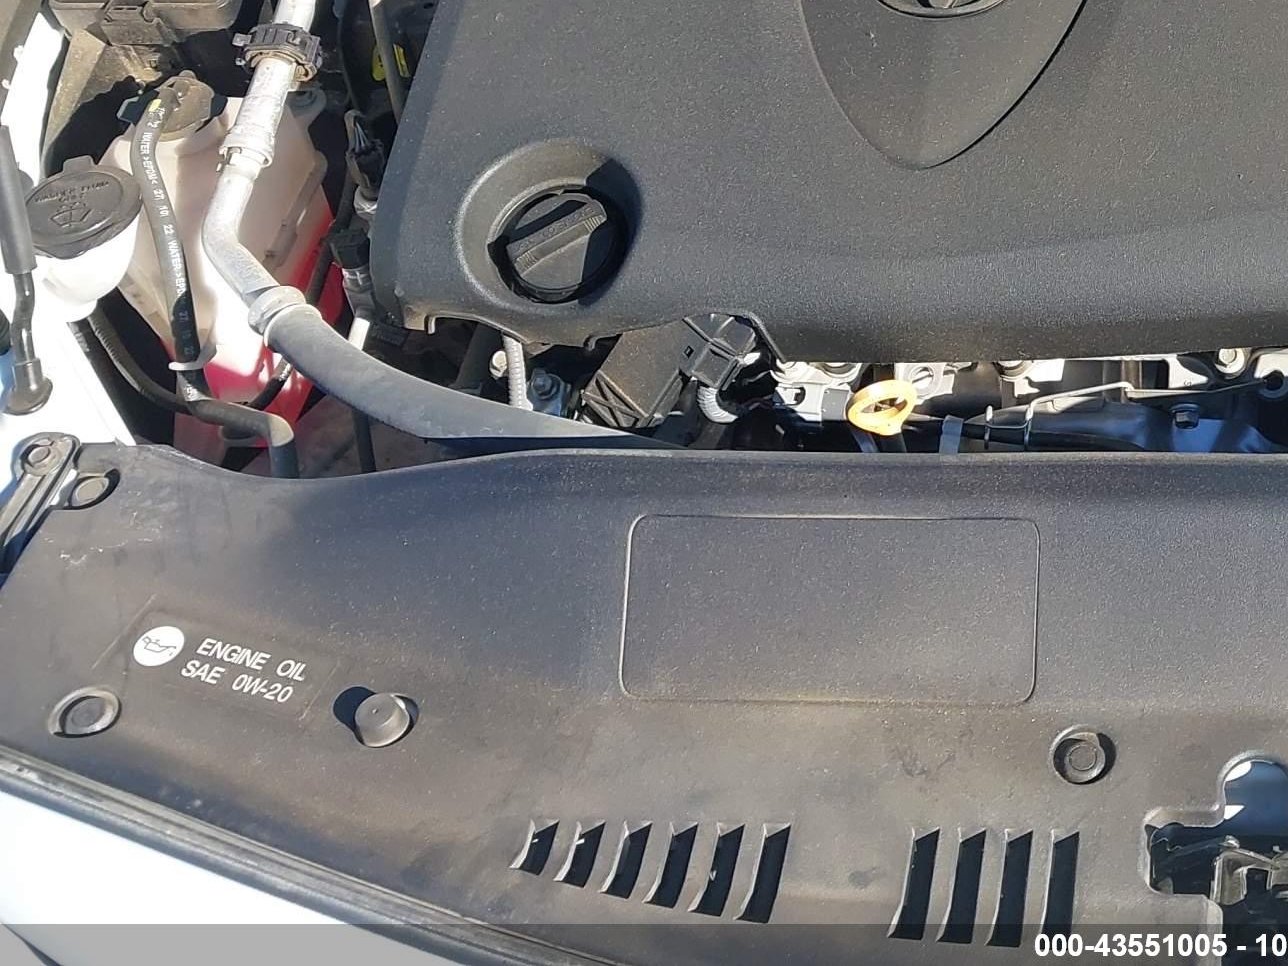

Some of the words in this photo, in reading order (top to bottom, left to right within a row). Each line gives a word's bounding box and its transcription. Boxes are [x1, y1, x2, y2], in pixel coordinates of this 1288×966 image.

[181, 659, 225, 685] SAE
[231, 673, 294, 703] 0W-20
[196, 637, 272, 671] ENGINE
[275, 659, 307, 682] OIL
